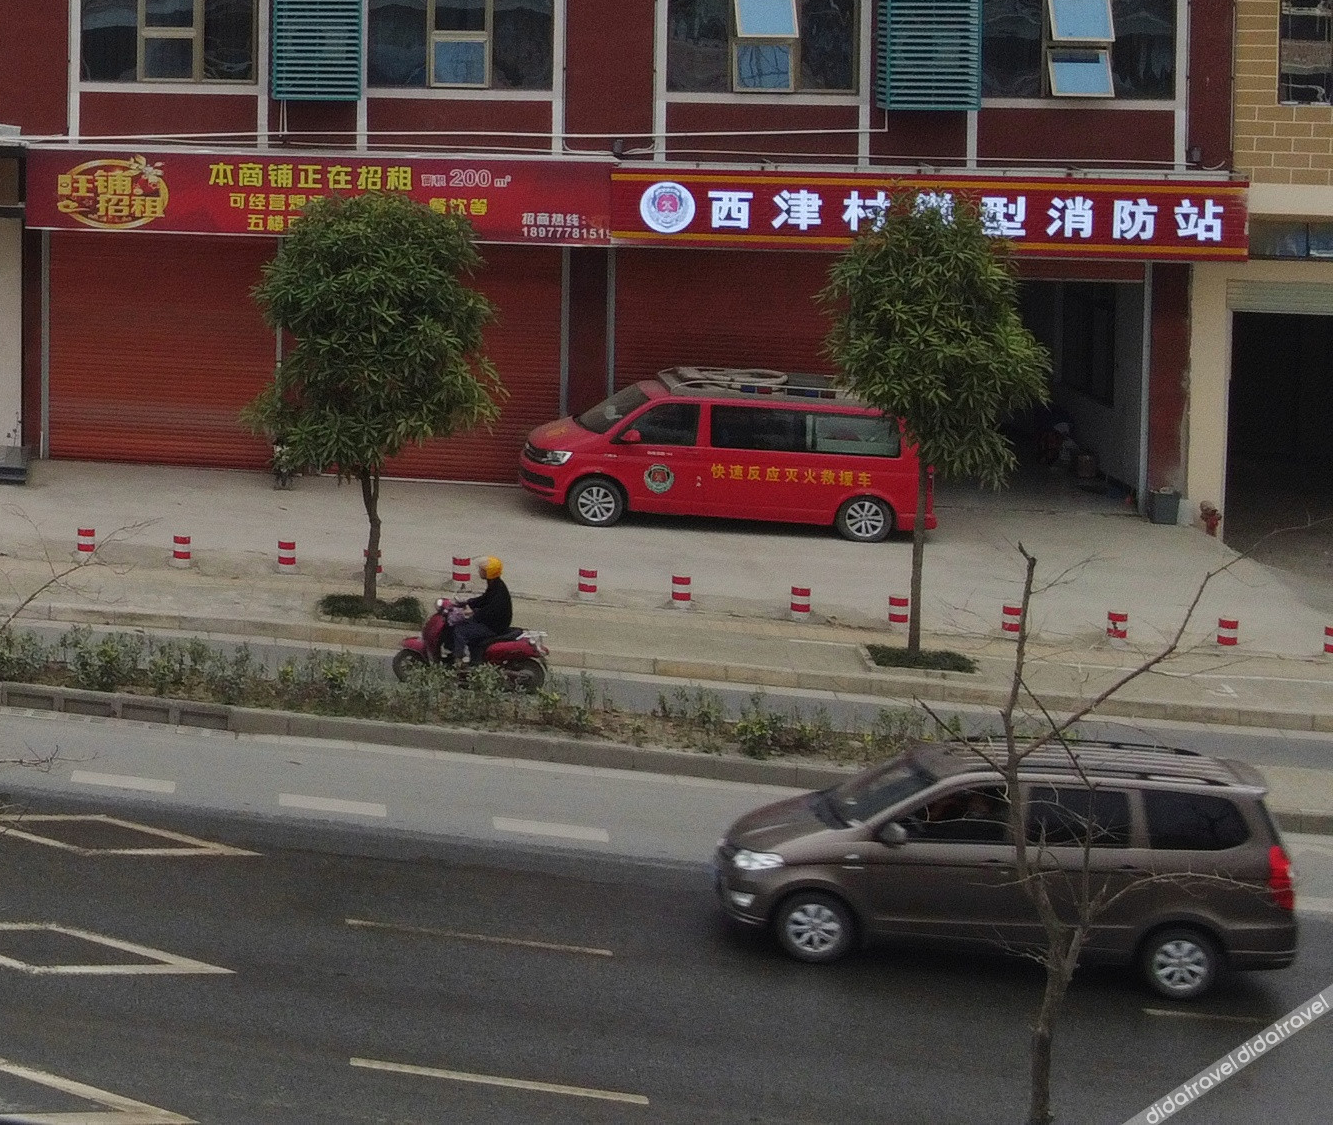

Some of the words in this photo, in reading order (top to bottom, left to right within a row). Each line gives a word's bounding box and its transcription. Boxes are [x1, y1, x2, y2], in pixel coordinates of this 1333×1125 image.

[208, 161, 413, 191] 本商铺正在招租
[449, 169, 492, 188] 200
[96, 194, 165, 218] 招租
[710, 462, 872, 488] 快速反应灭火救援车
